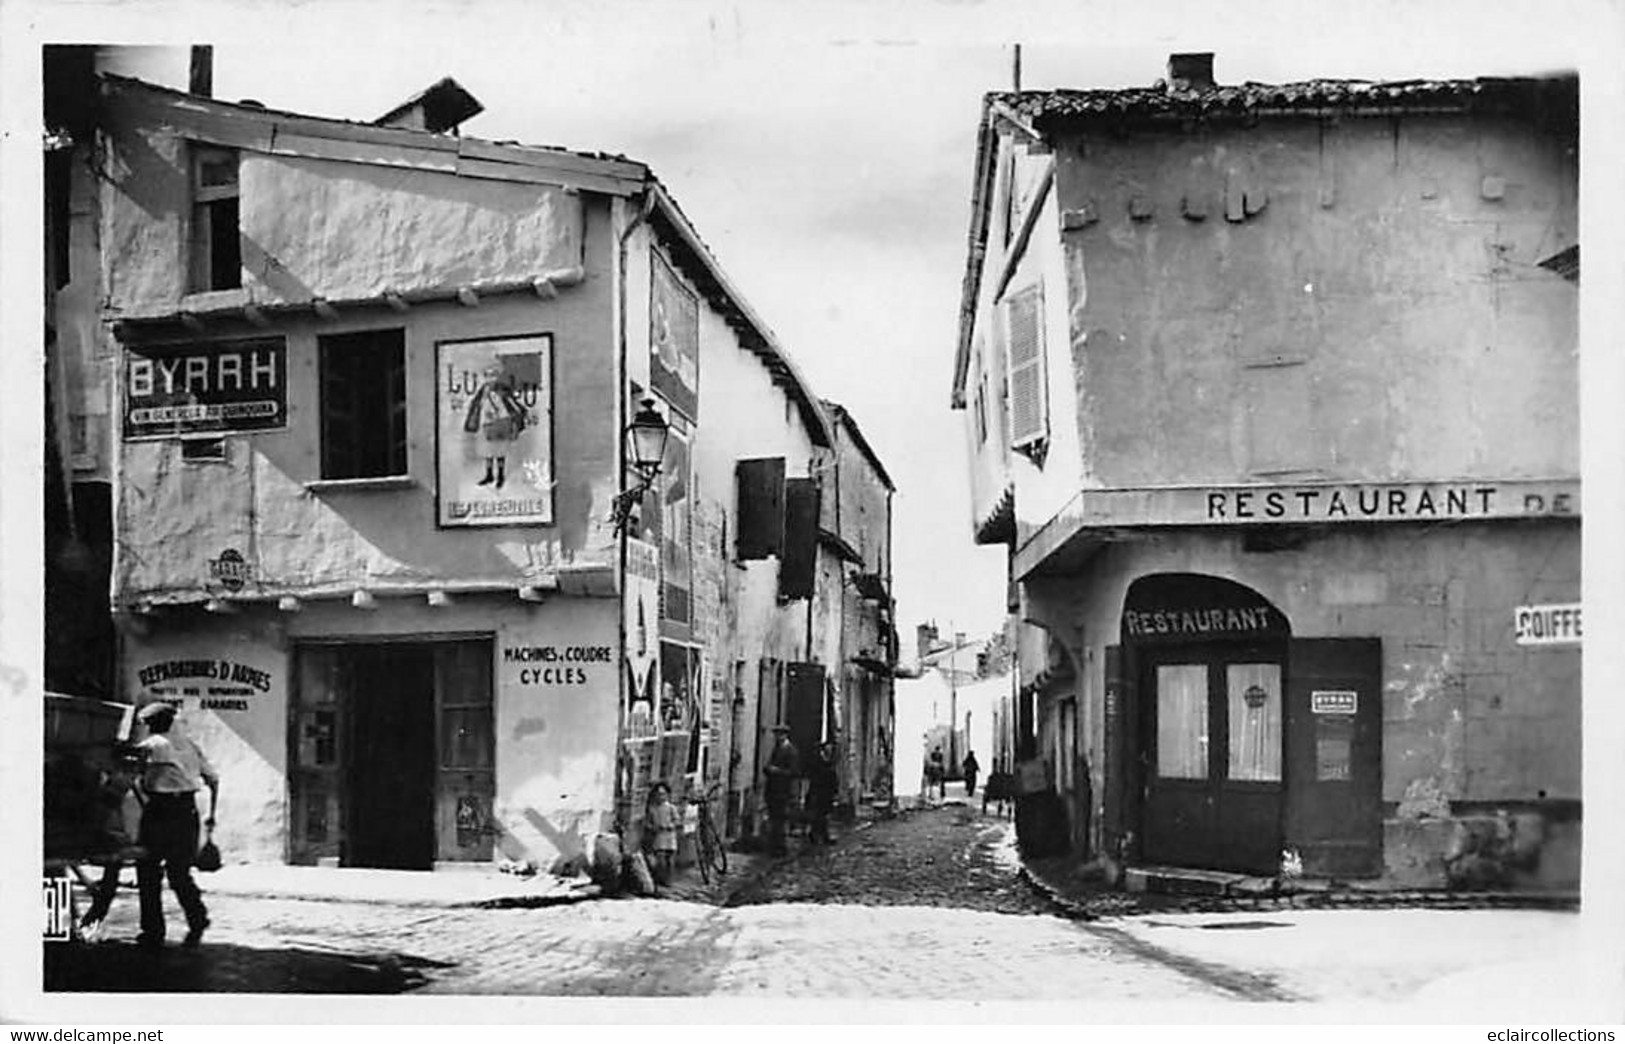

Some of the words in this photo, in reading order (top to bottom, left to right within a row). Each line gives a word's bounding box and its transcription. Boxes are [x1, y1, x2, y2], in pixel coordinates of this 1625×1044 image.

[131, 352, 276, 396] BYRRH
[1207, 488, 1496, 518] RESTAURANT
[1125, 608, 1268, 634] RESTAURANT
[504, 646, 557, 662] MACHINES
[565, 646, 612, 662] COUDRE
[520, 668, 586, 684] CYCLES
